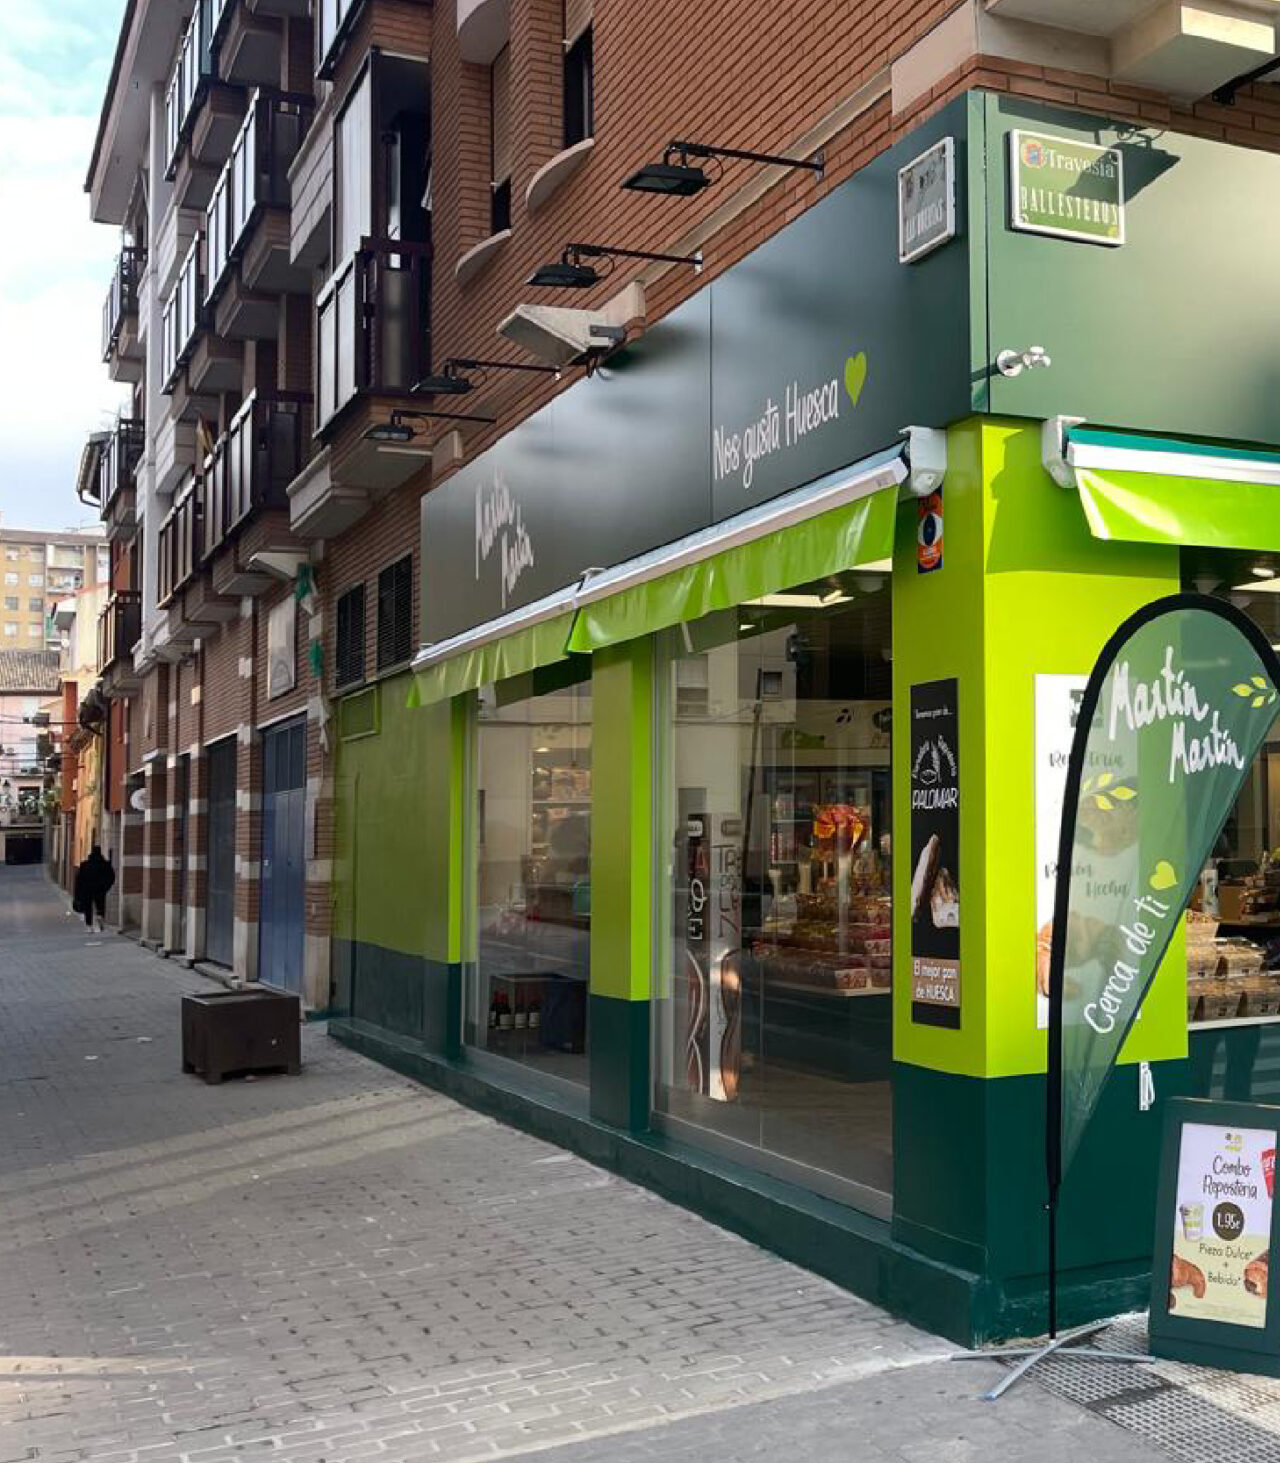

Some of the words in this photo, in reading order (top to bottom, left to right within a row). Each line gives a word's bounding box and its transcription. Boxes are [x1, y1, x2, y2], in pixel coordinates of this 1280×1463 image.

[1021, 186, 1118, 225] BALLESTEROS
[714, 425, 741, 480] Nos
[743, 398, 780, 489] gusta
[786, 378, 839, 446] Huesca
[912, 787, 958, 810] PALOMAR
[1133, 894, 1170, 918] ti
[1119, 921, 1155, 955] de
[1083, 959, 1140, 1033] Cerca
[1213, 1155, 1252, 1177] Combo
[1199, 1243, 1222, 1257] Pieza
